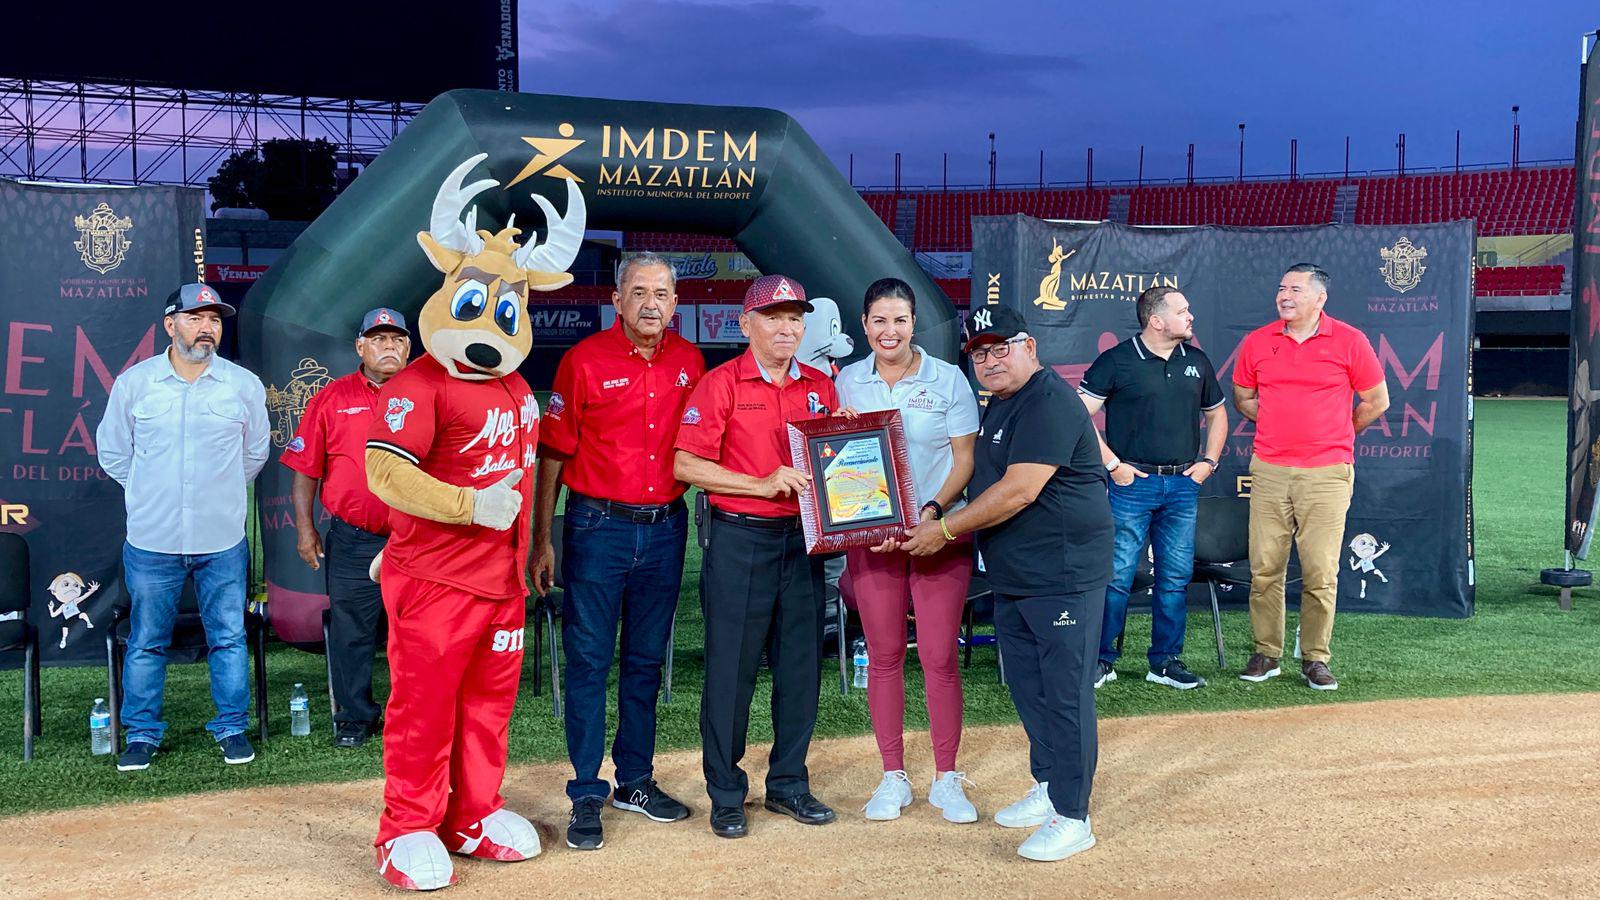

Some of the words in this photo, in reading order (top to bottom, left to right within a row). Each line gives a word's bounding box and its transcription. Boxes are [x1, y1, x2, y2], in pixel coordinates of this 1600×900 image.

[602, 125, 757, 162] IMDEM
[599, 162, 756, 189] MAZATLÁN
[597, 188, 645, 198] INSTITUTO
[647, 190, 693, 199] MUNICIPAL
[696, 191, 711, 200] DEL
[713, 192, 751, 200] DEPORTE
[1070, 272, 1178, 294] MAZATLÁN
[1360, 444, 1431, 458] DEPORTE
[13, 464, 49, 480] DEL
[471, 453, 516, 478] Salsa
[492, 628, 524, 652] 911
